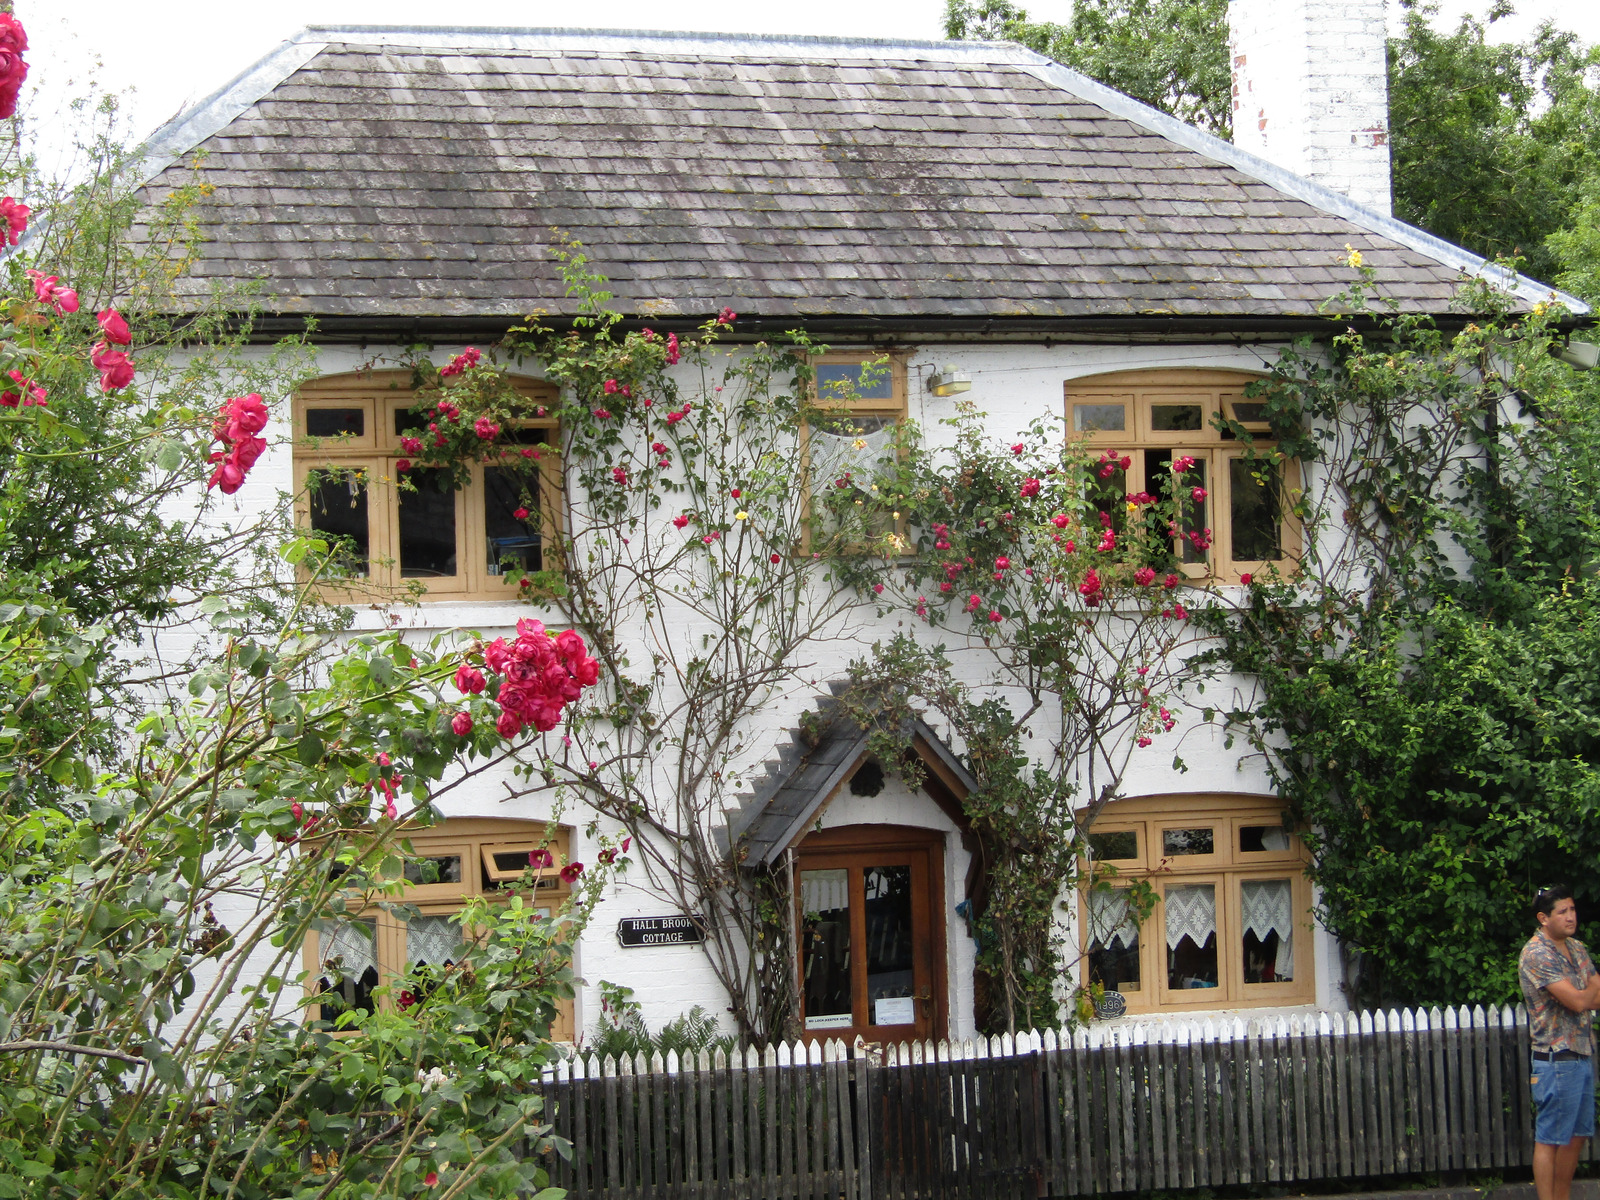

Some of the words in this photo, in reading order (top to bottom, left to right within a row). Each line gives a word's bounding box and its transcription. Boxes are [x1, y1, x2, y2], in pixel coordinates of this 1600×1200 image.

[632, 920, 658, 930] HALL
[662, 918, 693, 929] BROOK
[642, 932, 684, 943] COTTAGE
[1099, 1000, 1120, 1010] 1996
